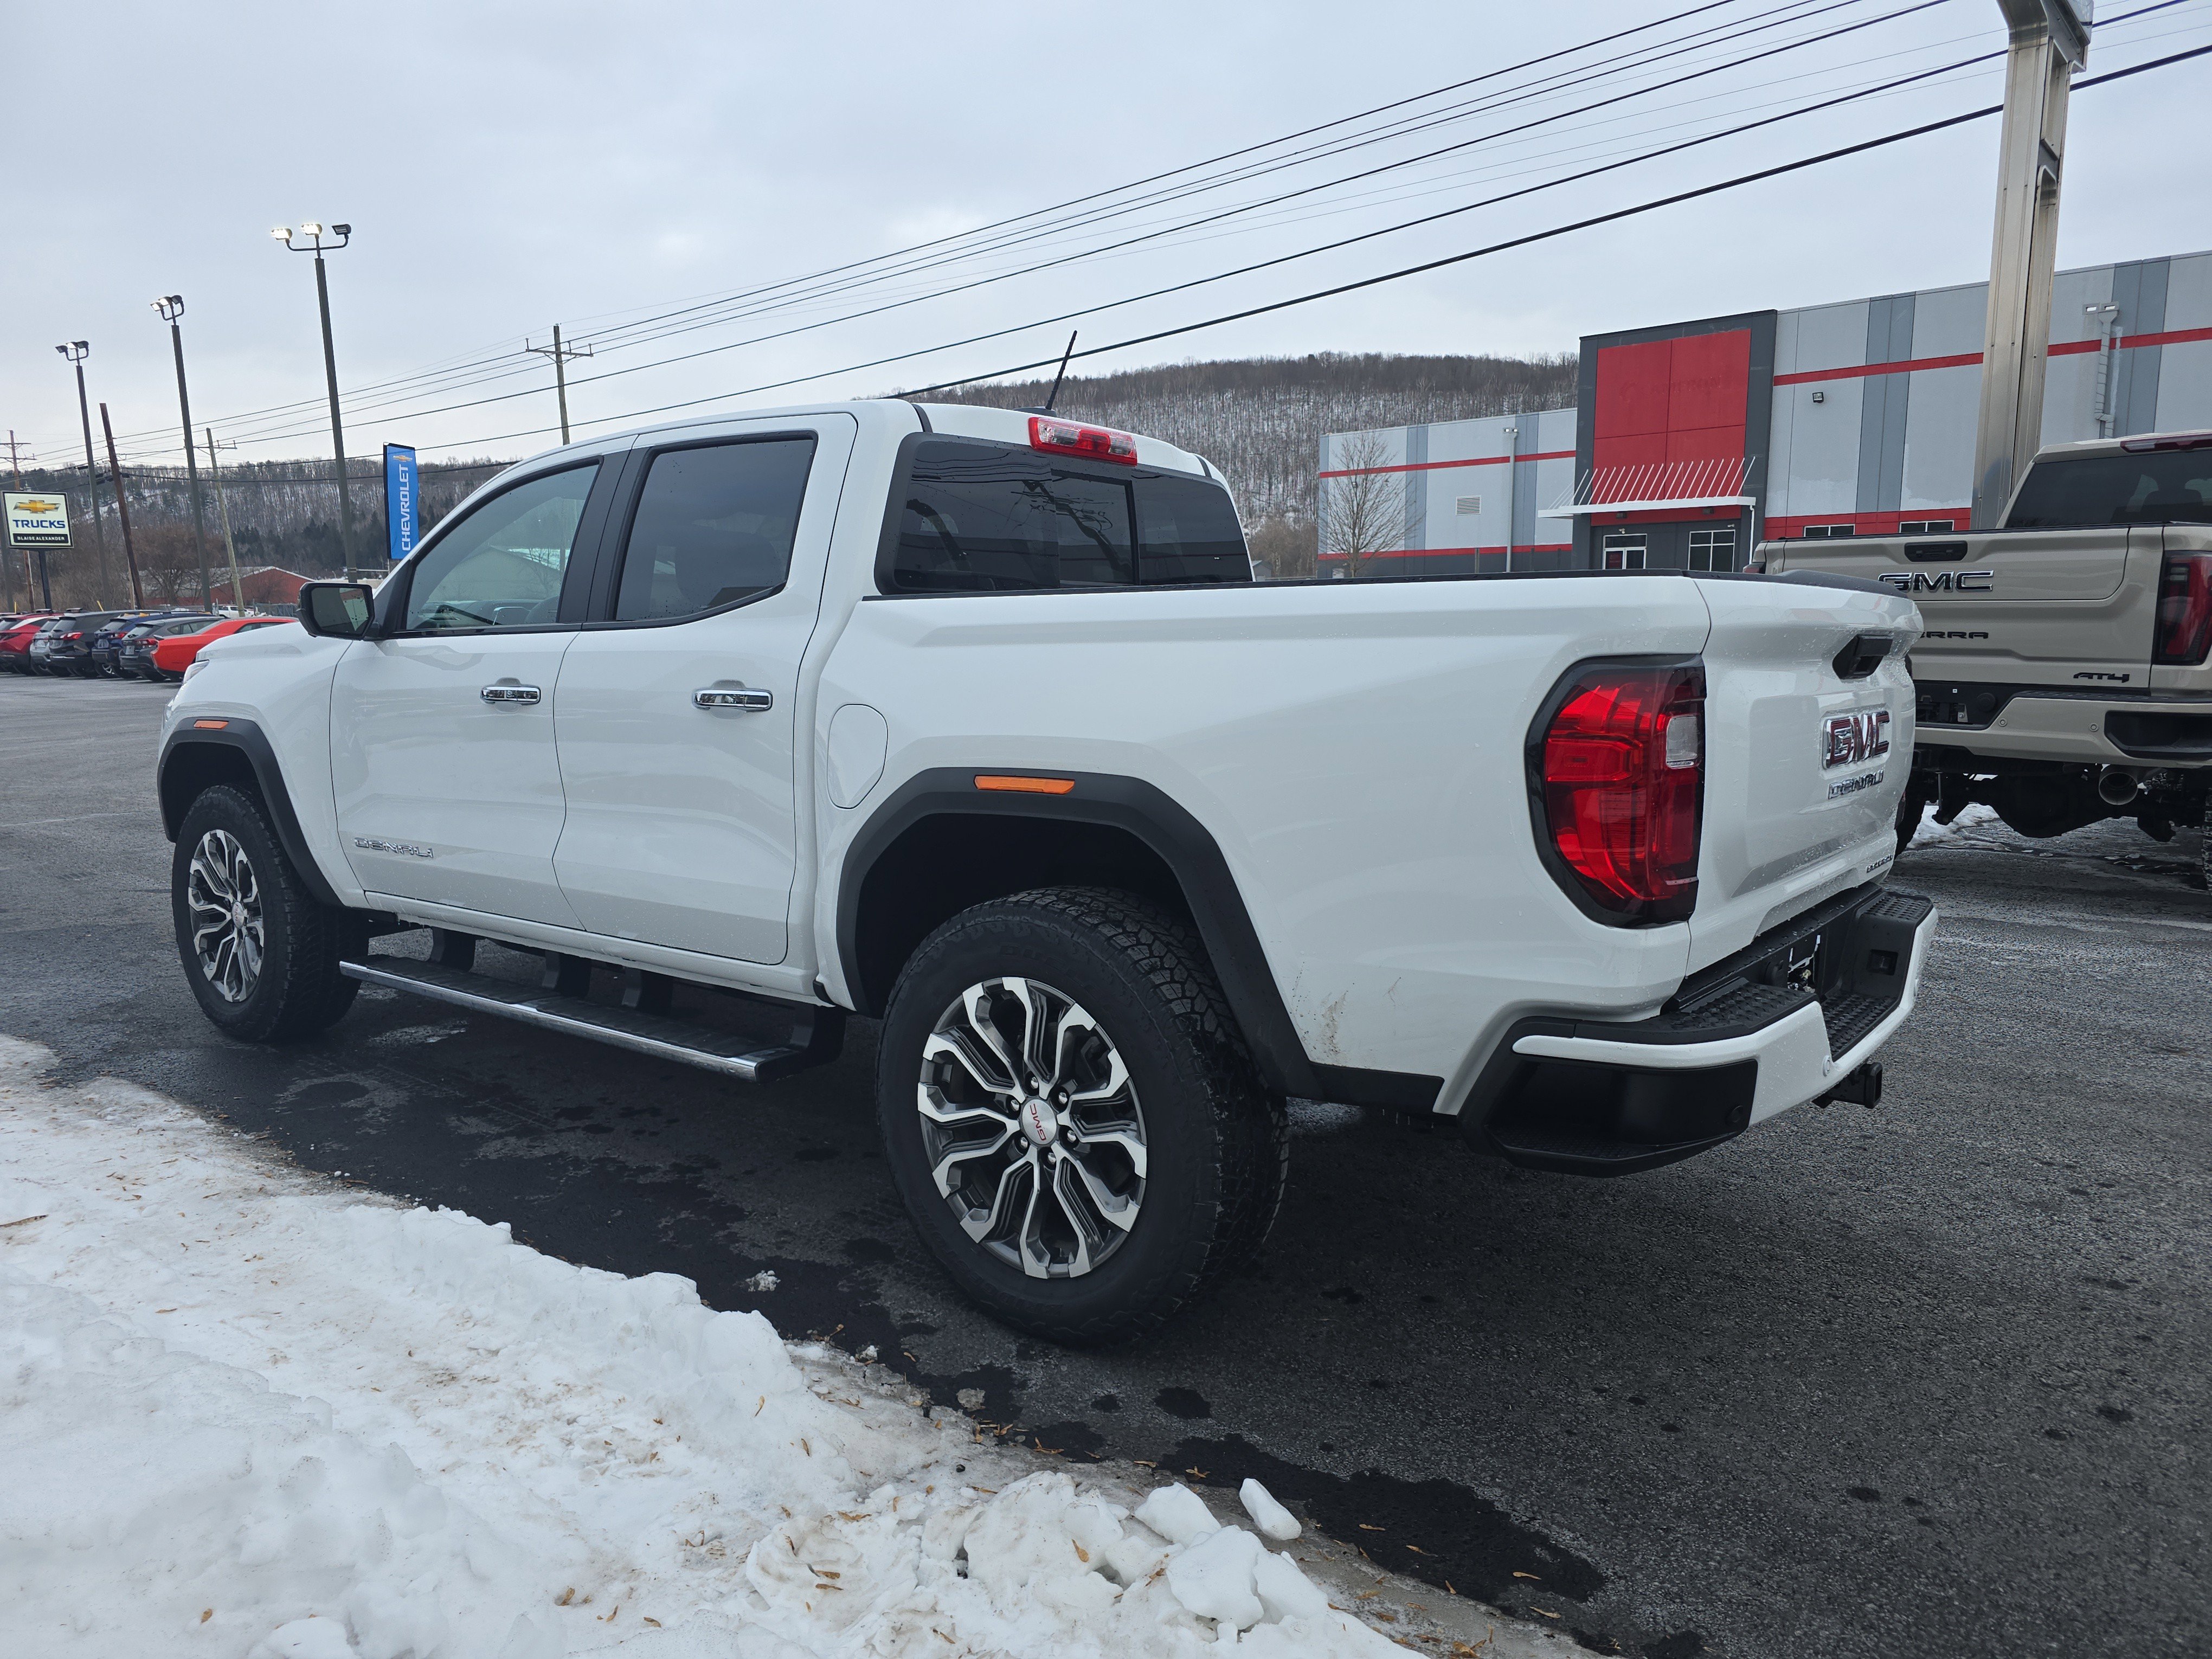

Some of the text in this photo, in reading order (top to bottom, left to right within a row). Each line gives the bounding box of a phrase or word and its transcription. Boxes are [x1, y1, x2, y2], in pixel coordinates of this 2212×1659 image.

[399, 464, 411, 551] CHEVROLET
[12, 519, 66, 529] TRUCKS
[1877, 570, 1995, 593] GMC
[2073, 672, 2130, 683] AT4
[1822, 711, 1890, 769] GMC
[1828, 769, 1884, 800] DENALI
[355, 837, 434, 858] DENALI
[1030, 1103, 1047, 1141] GMC
